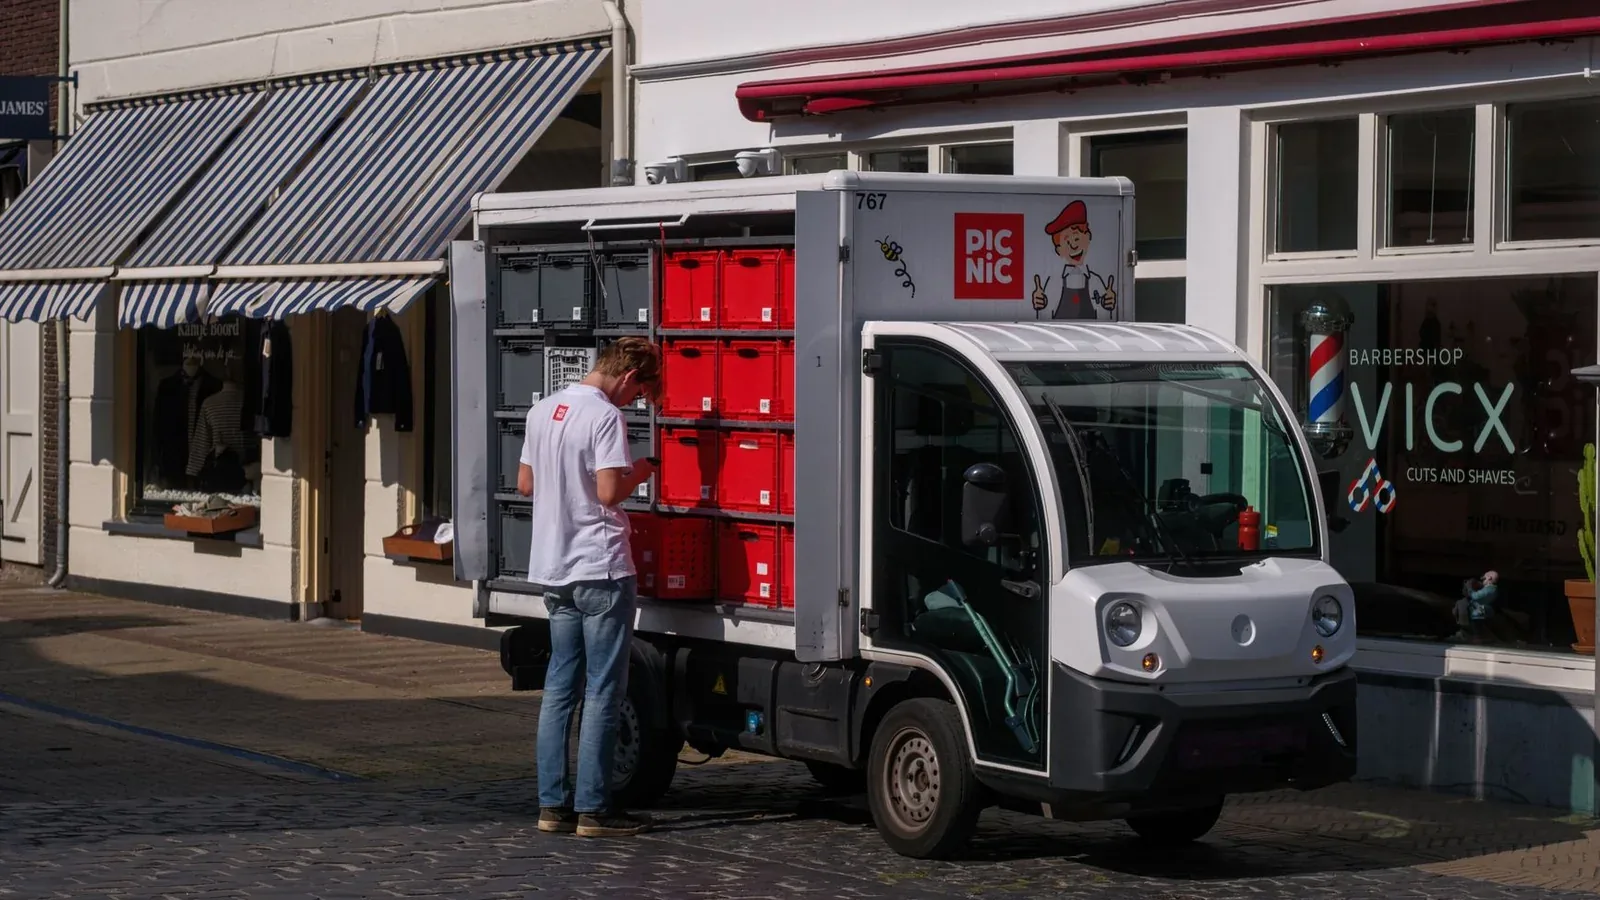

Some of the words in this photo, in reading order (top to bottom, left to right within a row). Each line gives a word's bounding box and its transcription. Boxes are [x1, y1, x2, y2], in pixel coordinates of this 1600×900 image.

[856, 193, 887, 210] 767
[965, 229, 1013, 256] PIC
[1350, 348, 1463, 366] BARBERSHOP
[1350, 381, 1516, 454] VICX
[1406, 467, 1438, 483] CUTS
[1439, 468, 1465, 484] AND
[1468, 469, 1516, 485] SHAVES
